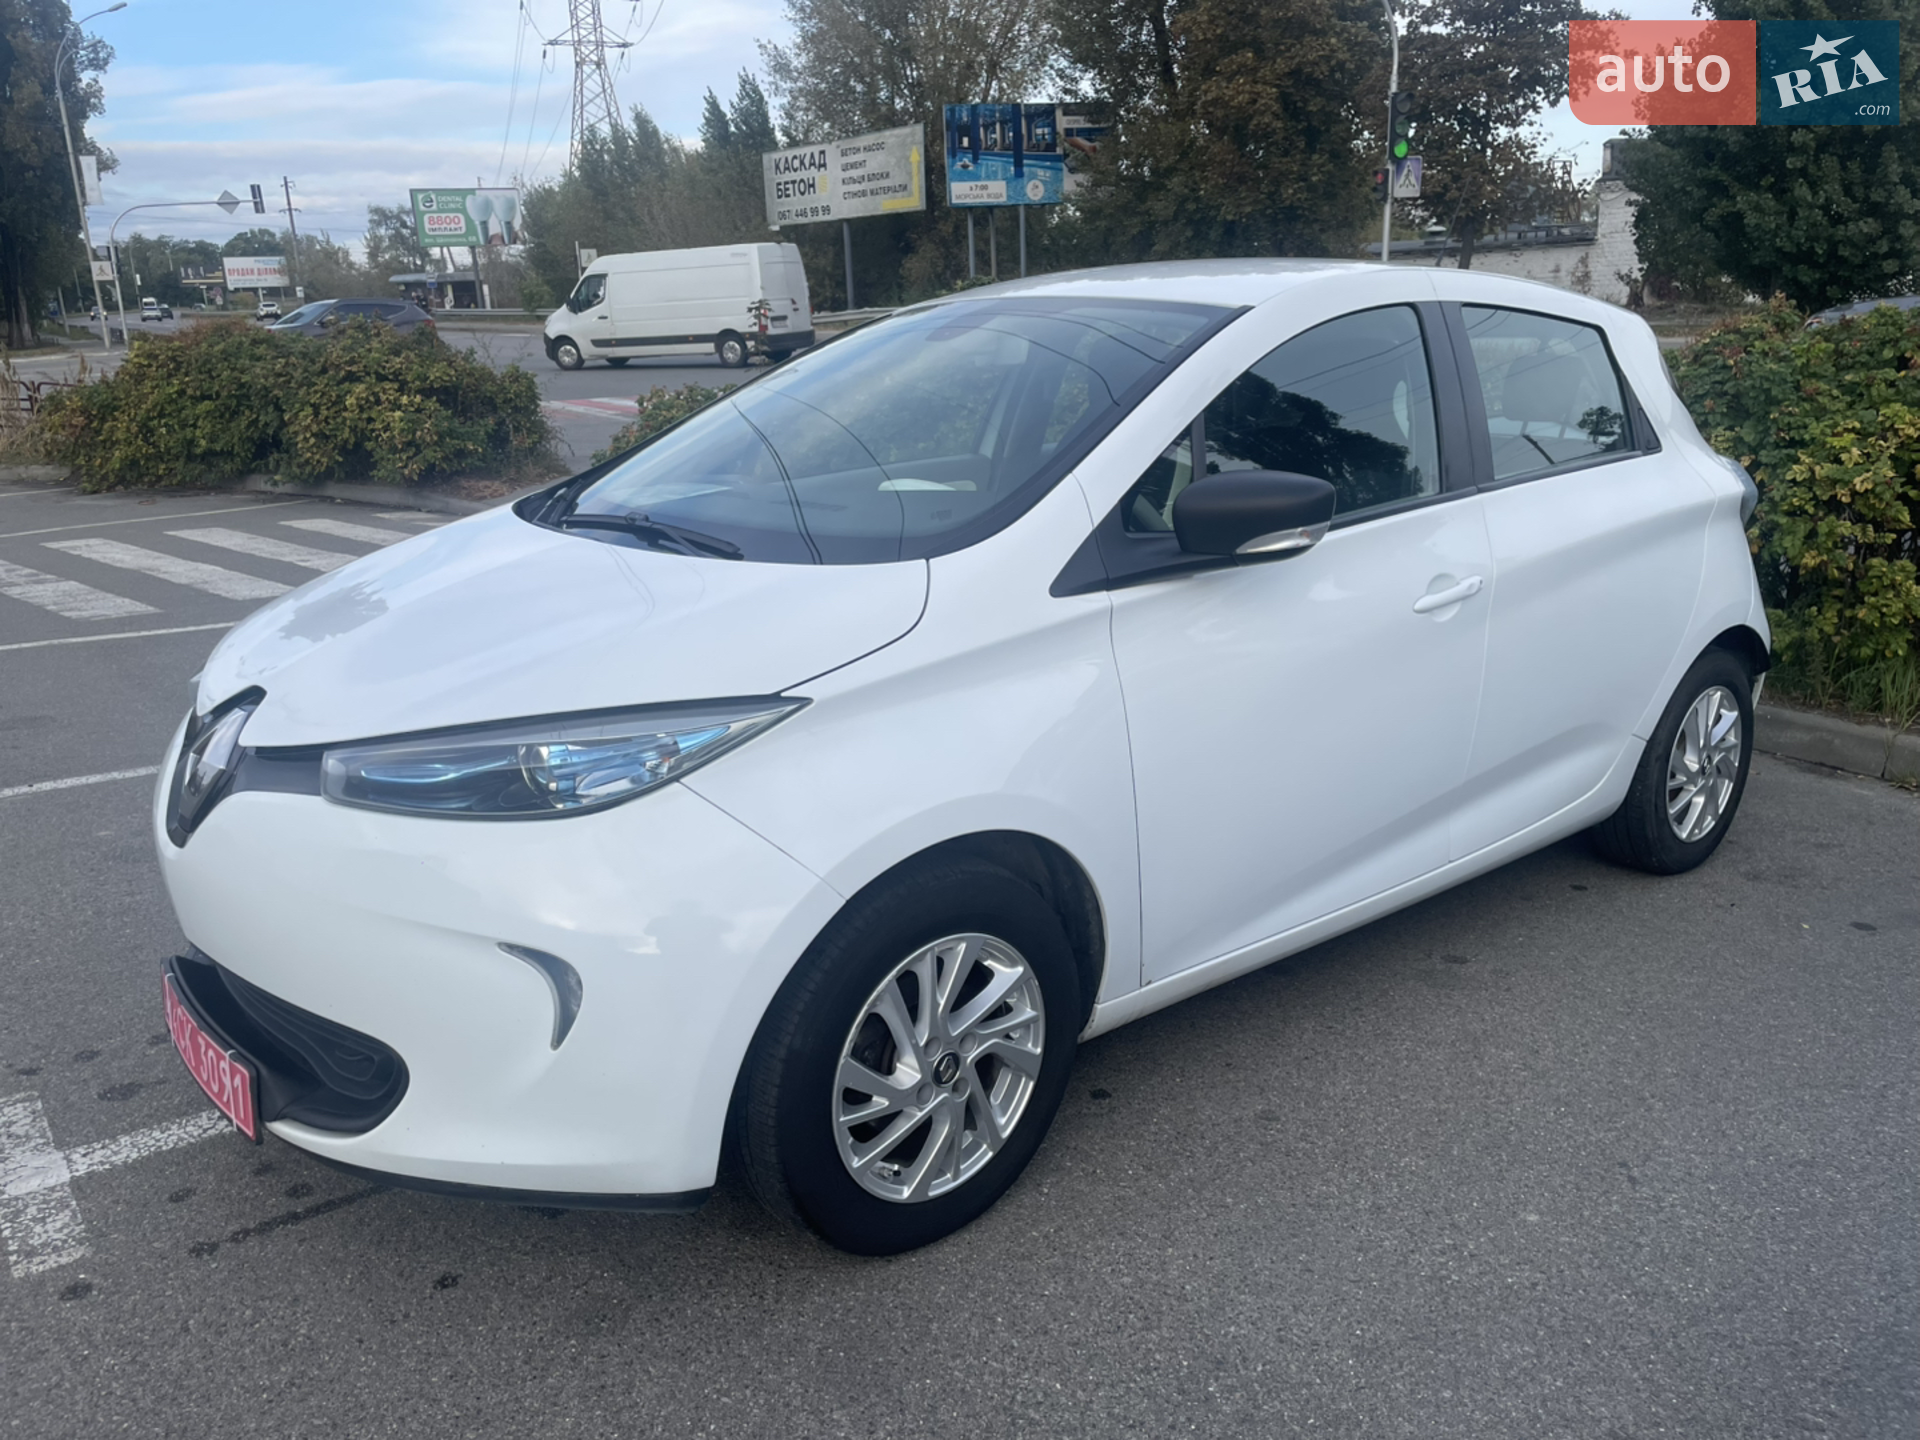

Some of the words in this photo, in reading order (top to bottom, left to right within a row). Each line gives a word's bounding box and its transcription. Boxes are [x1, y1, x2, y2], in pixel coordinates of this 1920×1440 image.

[840, 145, 861, 157] БЕТОН
[862, 142, 885, 154] НАСОС
[774, 149, 828, 175] КАСКАД
[840, 159, 867, 172] ЦЕМЕНТ
[866, 171, 890, 183] БЛОКИ
[775, 176, 817, 199] БЕТОН
[869, 184, 908, 198] МАТЕРІАЛИ
[794, 207, 809, 219] 446
[809, 206, 819, 217] 99
[820, 204, 831, 216] 99
[427, 215, 462, 226] 8800
[197, 1034, 245, 1120] 3091
